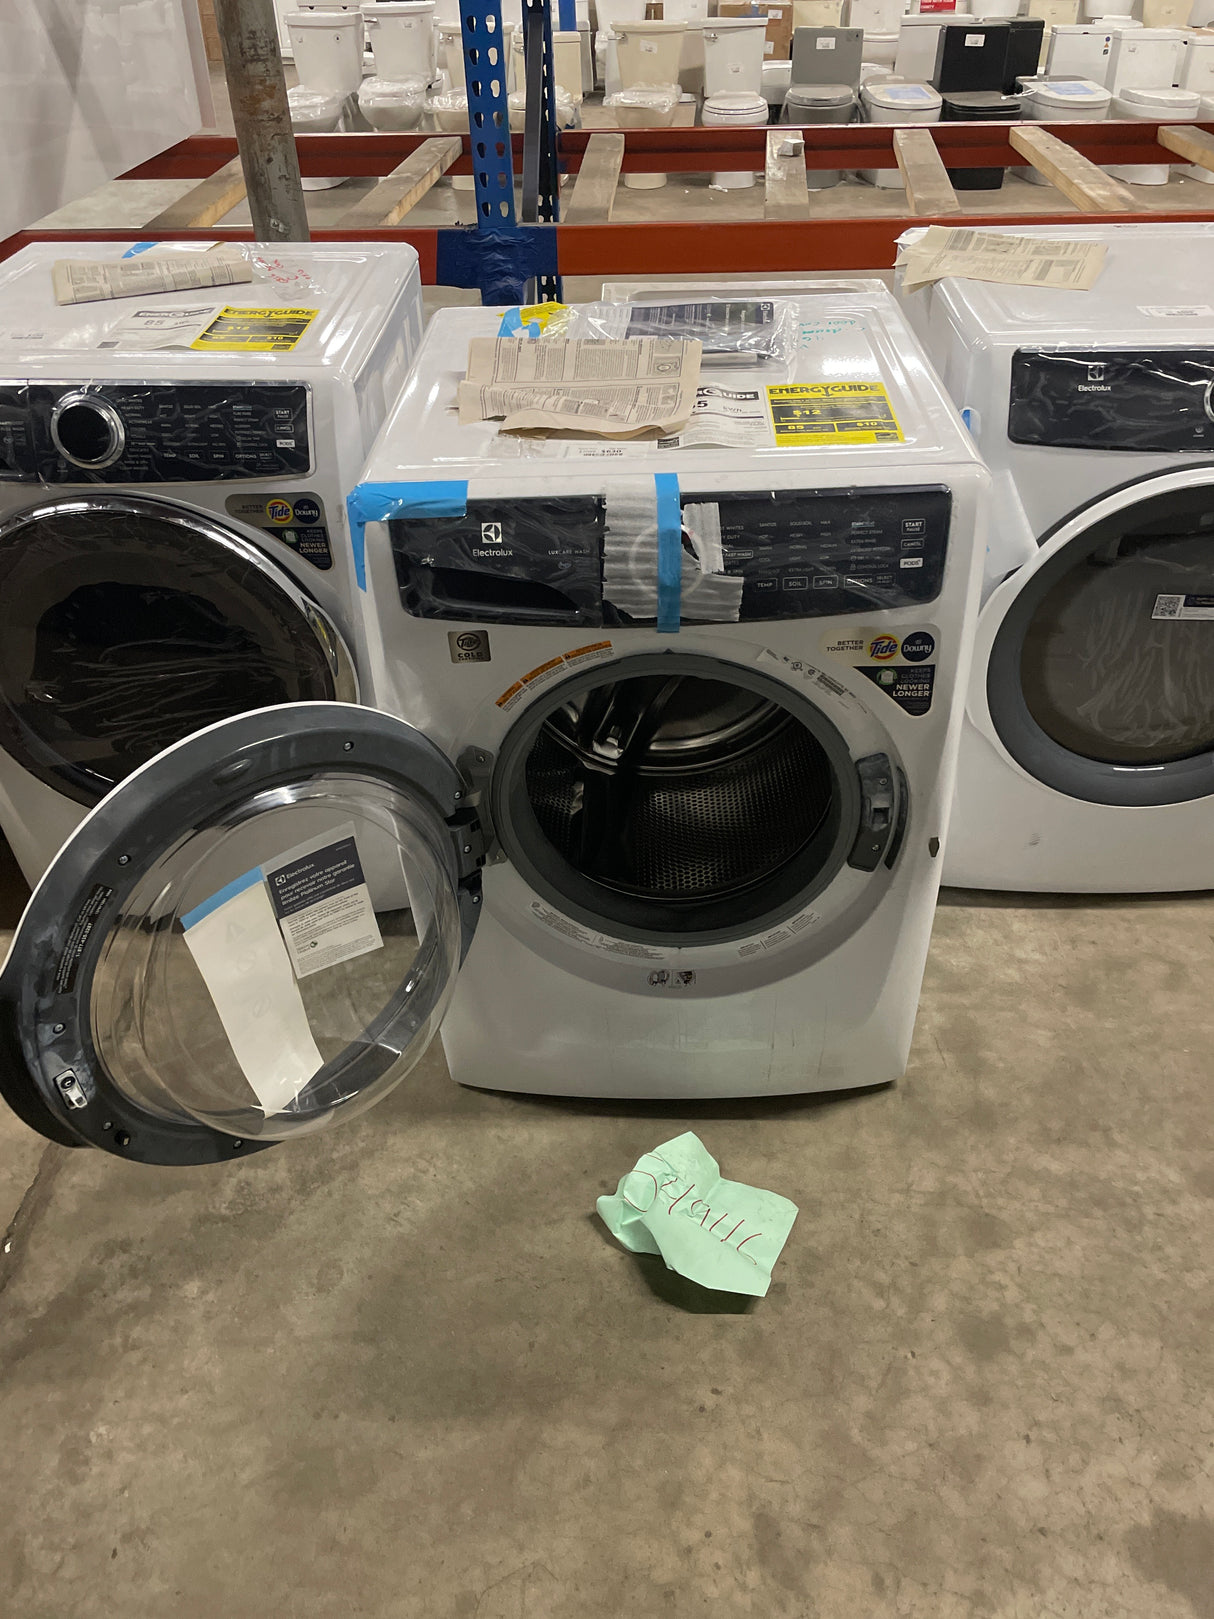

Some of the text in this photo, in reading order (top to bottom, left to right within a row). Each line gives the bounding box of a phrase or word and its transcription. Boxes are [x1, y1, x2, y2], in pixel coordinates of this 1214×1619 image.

[769, 384, 881, 397] ENERGYGUIDE
[1077, 384, 1112, 392] Electrolux
[268, 504, 291, 520] Tide
[294, 508, 319, 517] Downy
[472, 549, 513, 557] Electrolux
[869, 640, 899, 658] Tide
[902, 644, 932, 653] Downy
[286, 863, 315, 879] Electrolux
[310, 870, 325, 880] votre
[301, 883, 324, 896] Platinum
[325, 878, 336, 886] Star
